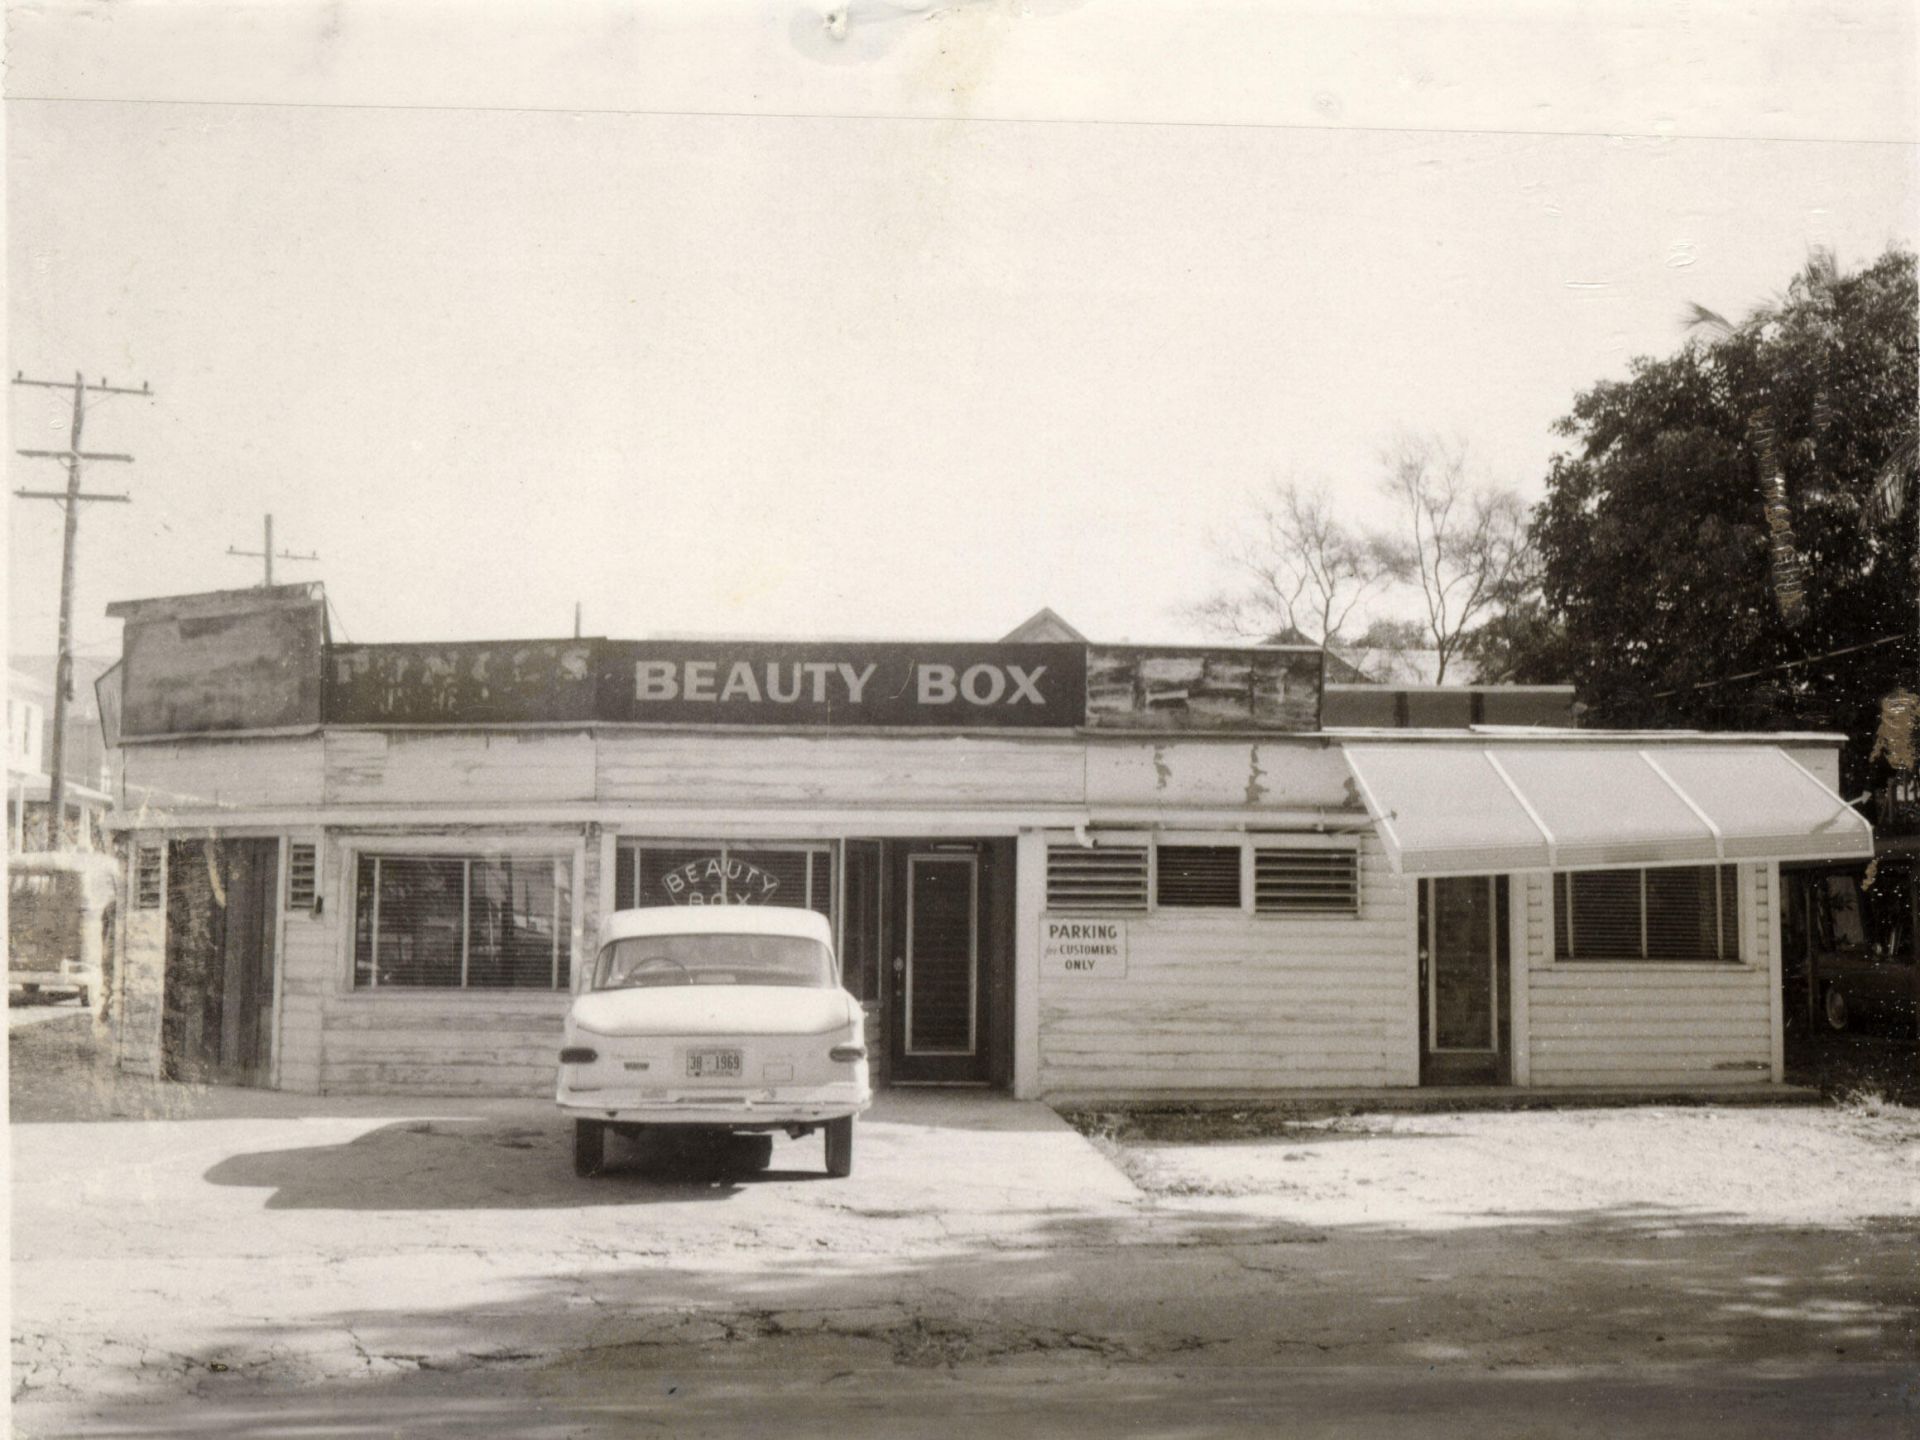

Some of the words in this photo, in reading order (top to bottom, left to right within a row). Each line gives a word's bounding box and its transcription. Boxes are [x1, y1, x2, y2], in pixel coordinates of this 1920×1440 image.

[634, 660, 878, 704] BEAUTY
[916, 663, 1048, 706] BOX
[666, 859, 778, 893] BEAUTY
[1049, 924, 1118, 939] PARKING
[1059, 944, 1118, 955] CUSTOMERS
[1065, 959, 1097, 970] ONLY
